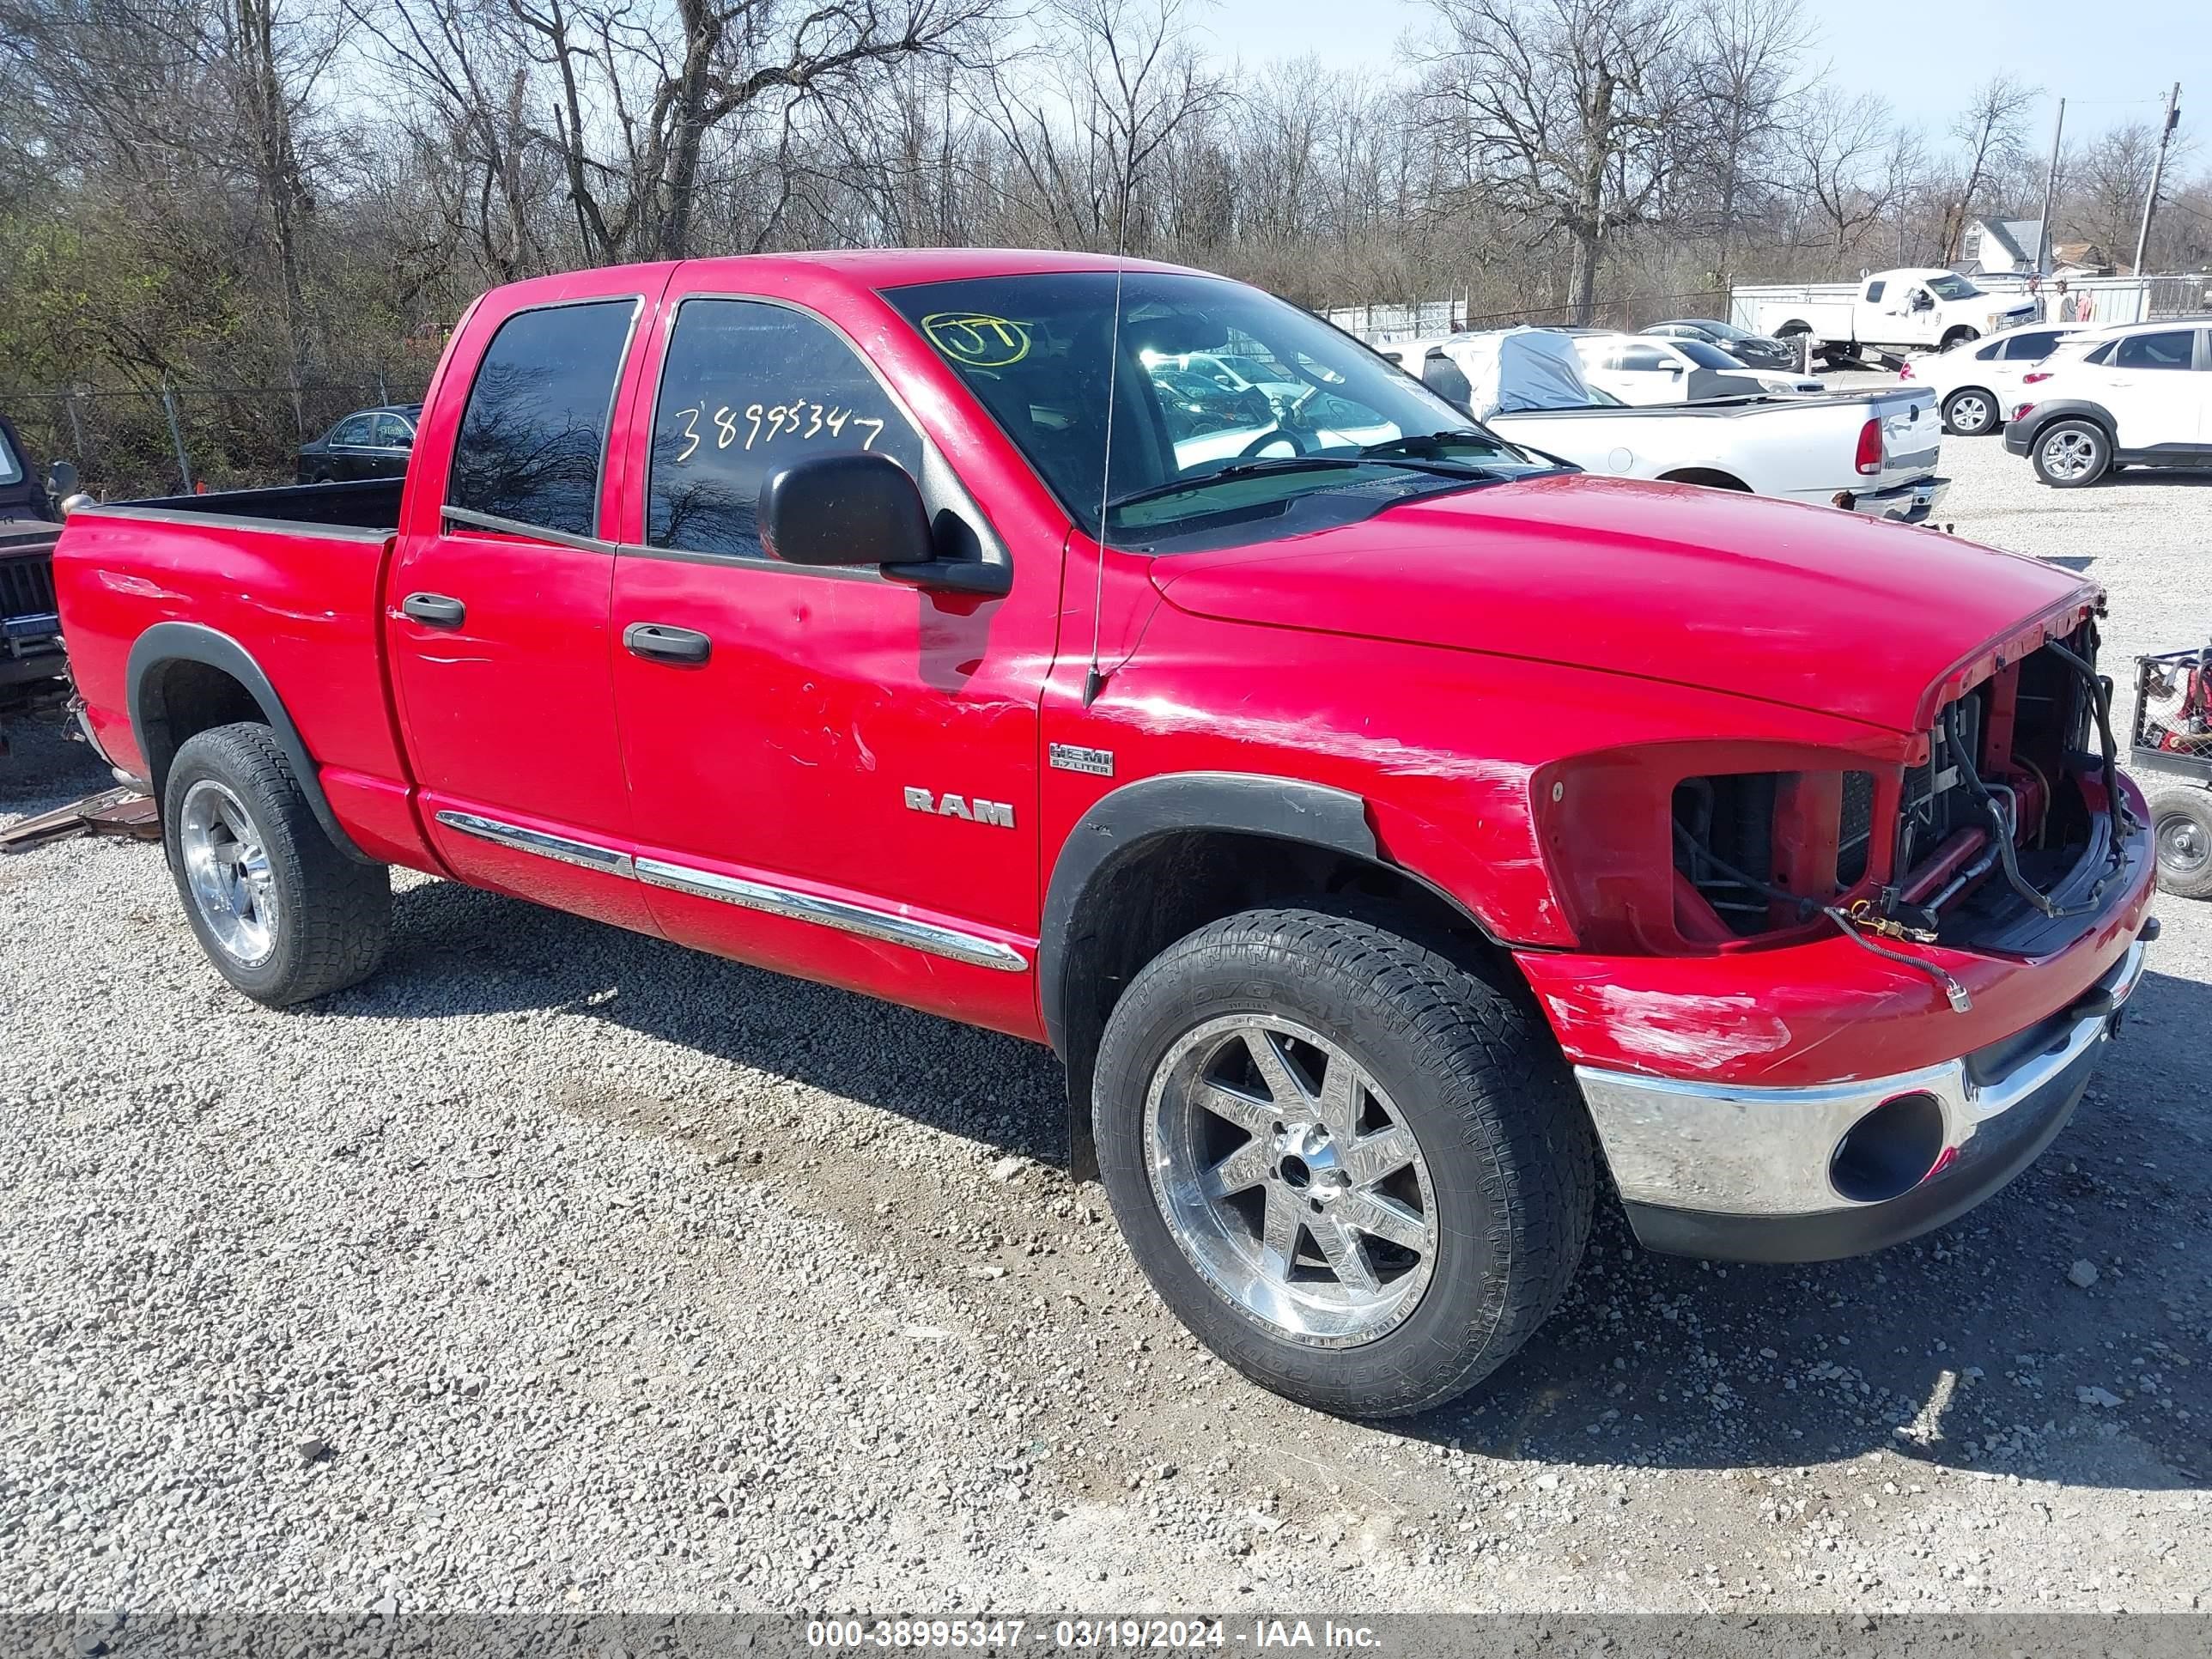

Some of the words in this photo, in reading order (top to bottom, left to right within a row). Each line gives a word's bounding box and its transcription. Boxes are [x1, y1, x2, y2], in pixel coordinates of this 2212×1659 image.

[675, 398, 884, 462] 38995347
[1049, 743, 1113, 766] HEMI
[1052, 759, 1070, 768] 5.7
[1074, 763, 1109, 773] LITER
[903, 786, 1016, 829] RAM
